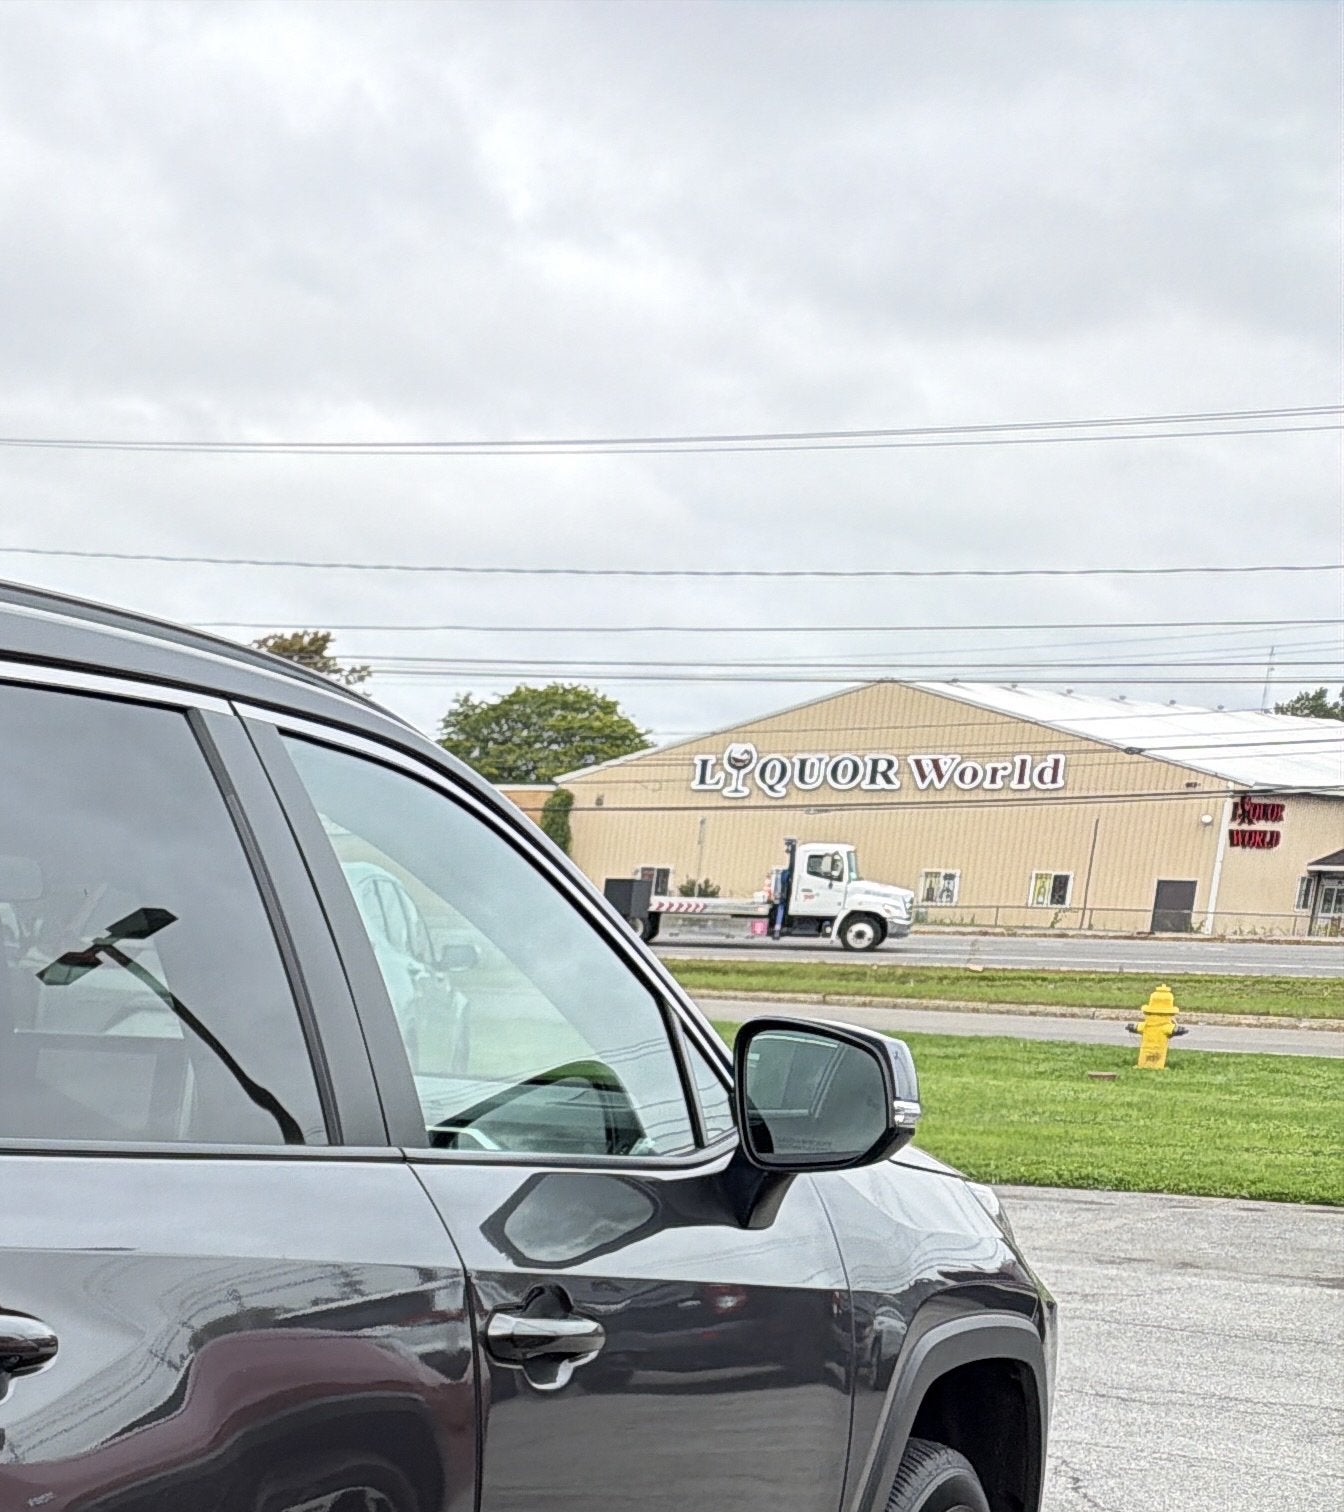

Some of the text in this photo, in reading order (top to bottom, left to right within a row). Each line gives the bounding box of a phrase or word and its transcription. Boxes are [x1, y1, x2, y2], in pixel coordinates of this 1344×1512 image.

[691, 743, 1065, 797] LIQUOR World
[1228, 829, 1281, 849] WORLD
